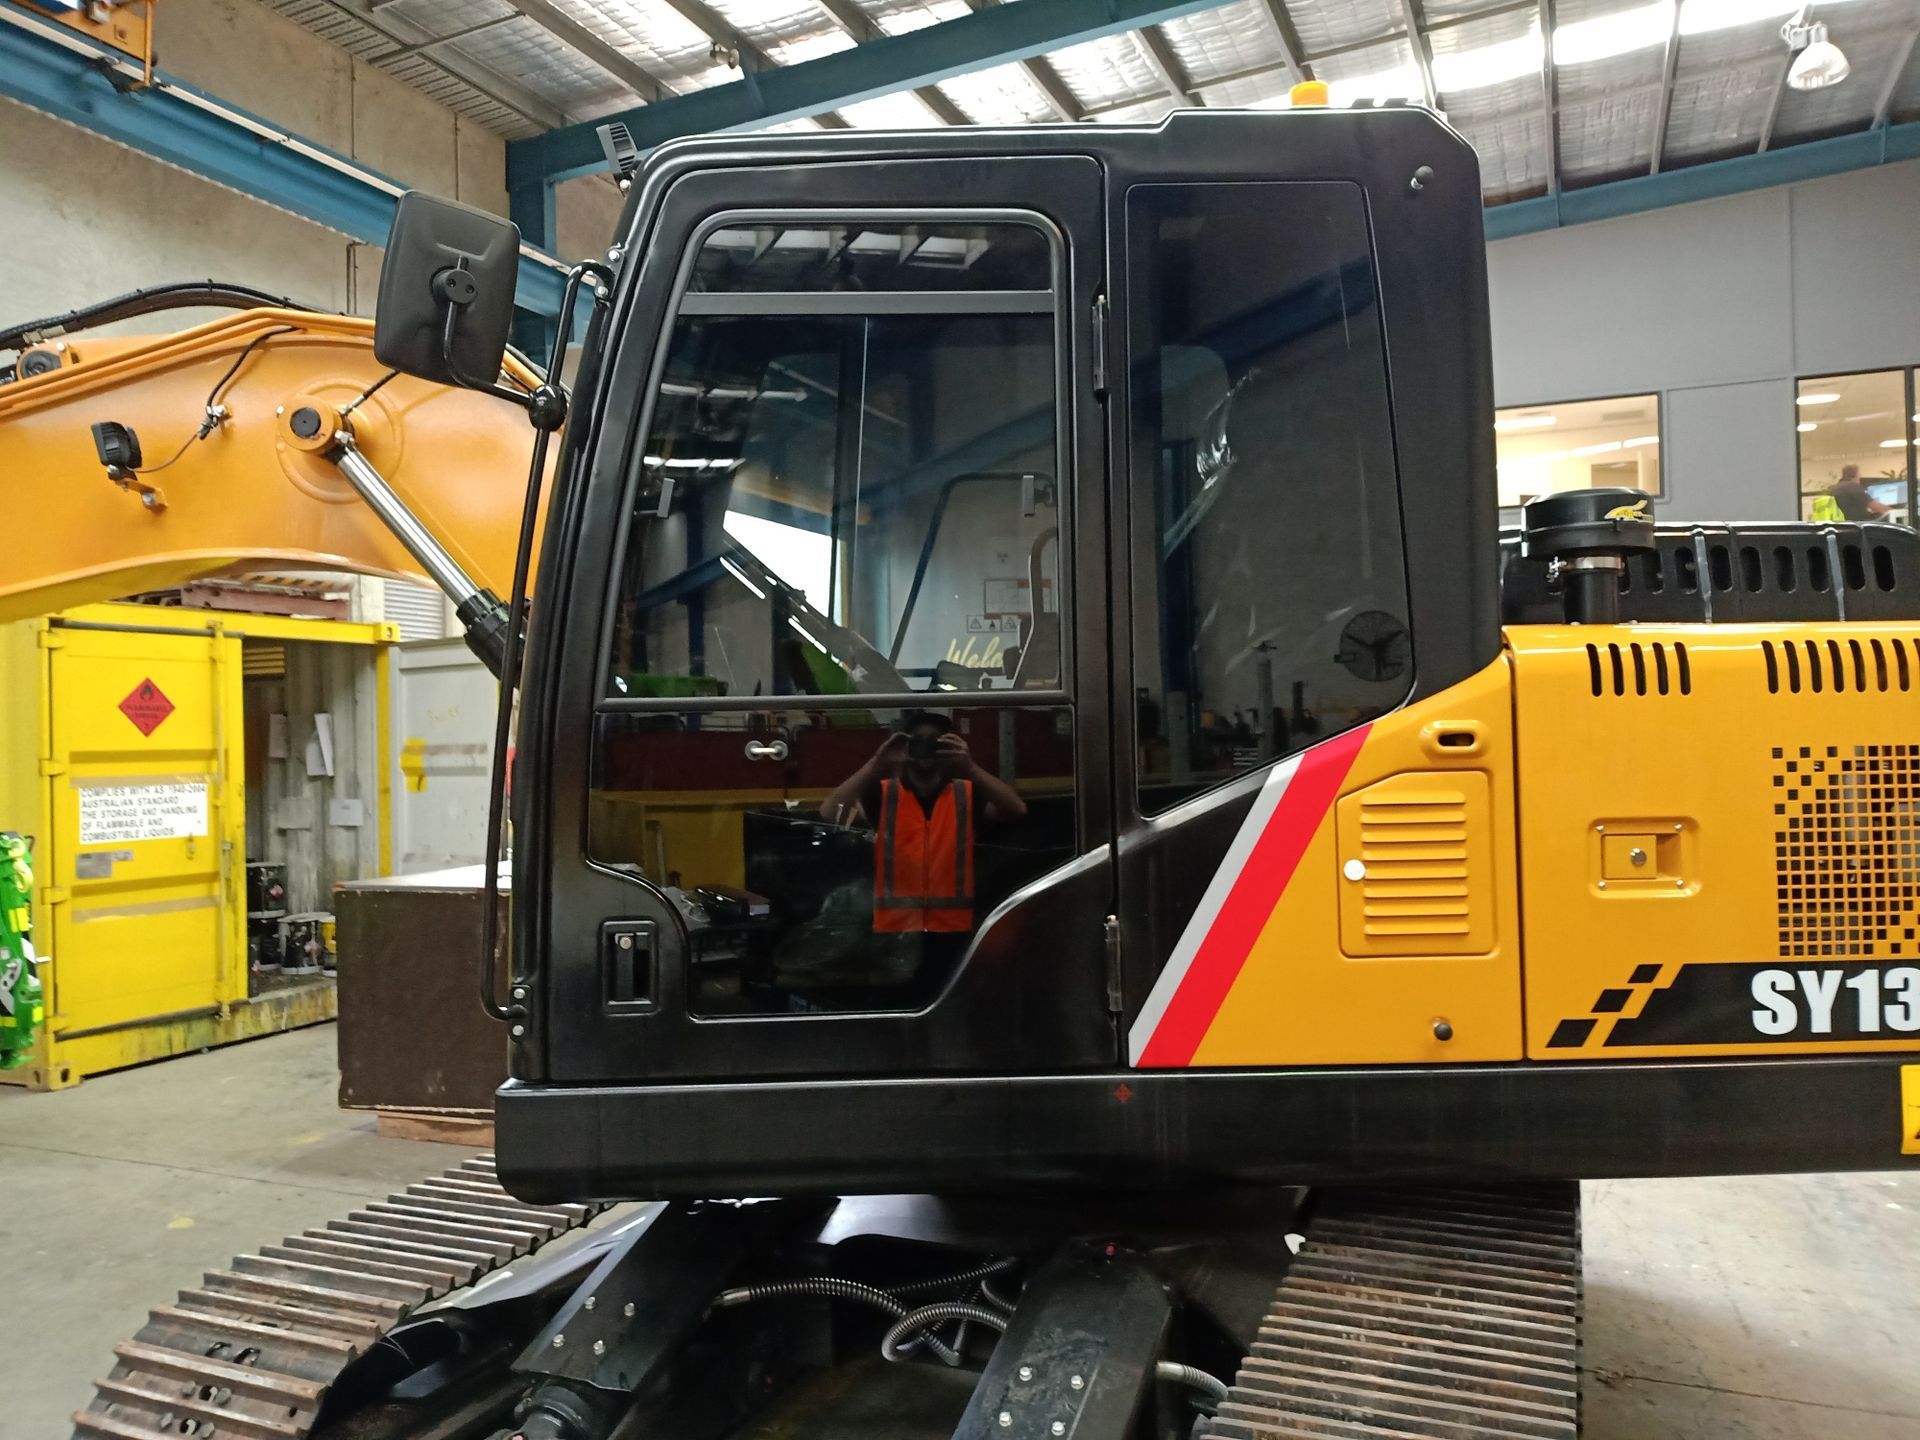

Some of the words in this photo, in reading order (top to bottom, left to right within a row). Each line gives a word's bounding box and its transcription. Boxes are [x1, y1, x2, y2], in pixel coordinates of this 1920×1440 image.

[81, 799, 133, 809] AUSTRALIAN
[81, 810, 97, 820] THE
[101, 808, 137, 819] STORAGE
[142, 807, 157, 816] AND
[160, 804, 198, 815] HANDLING
[81, 821, 92, 831] OF
[96, 819, 144, 830] FLAMMABLE
[148, 817, 163, 826] AND
[81, 830, 140, 842] COMBUSTIBLE
[1751, 967, 1920, 1036] SY13
